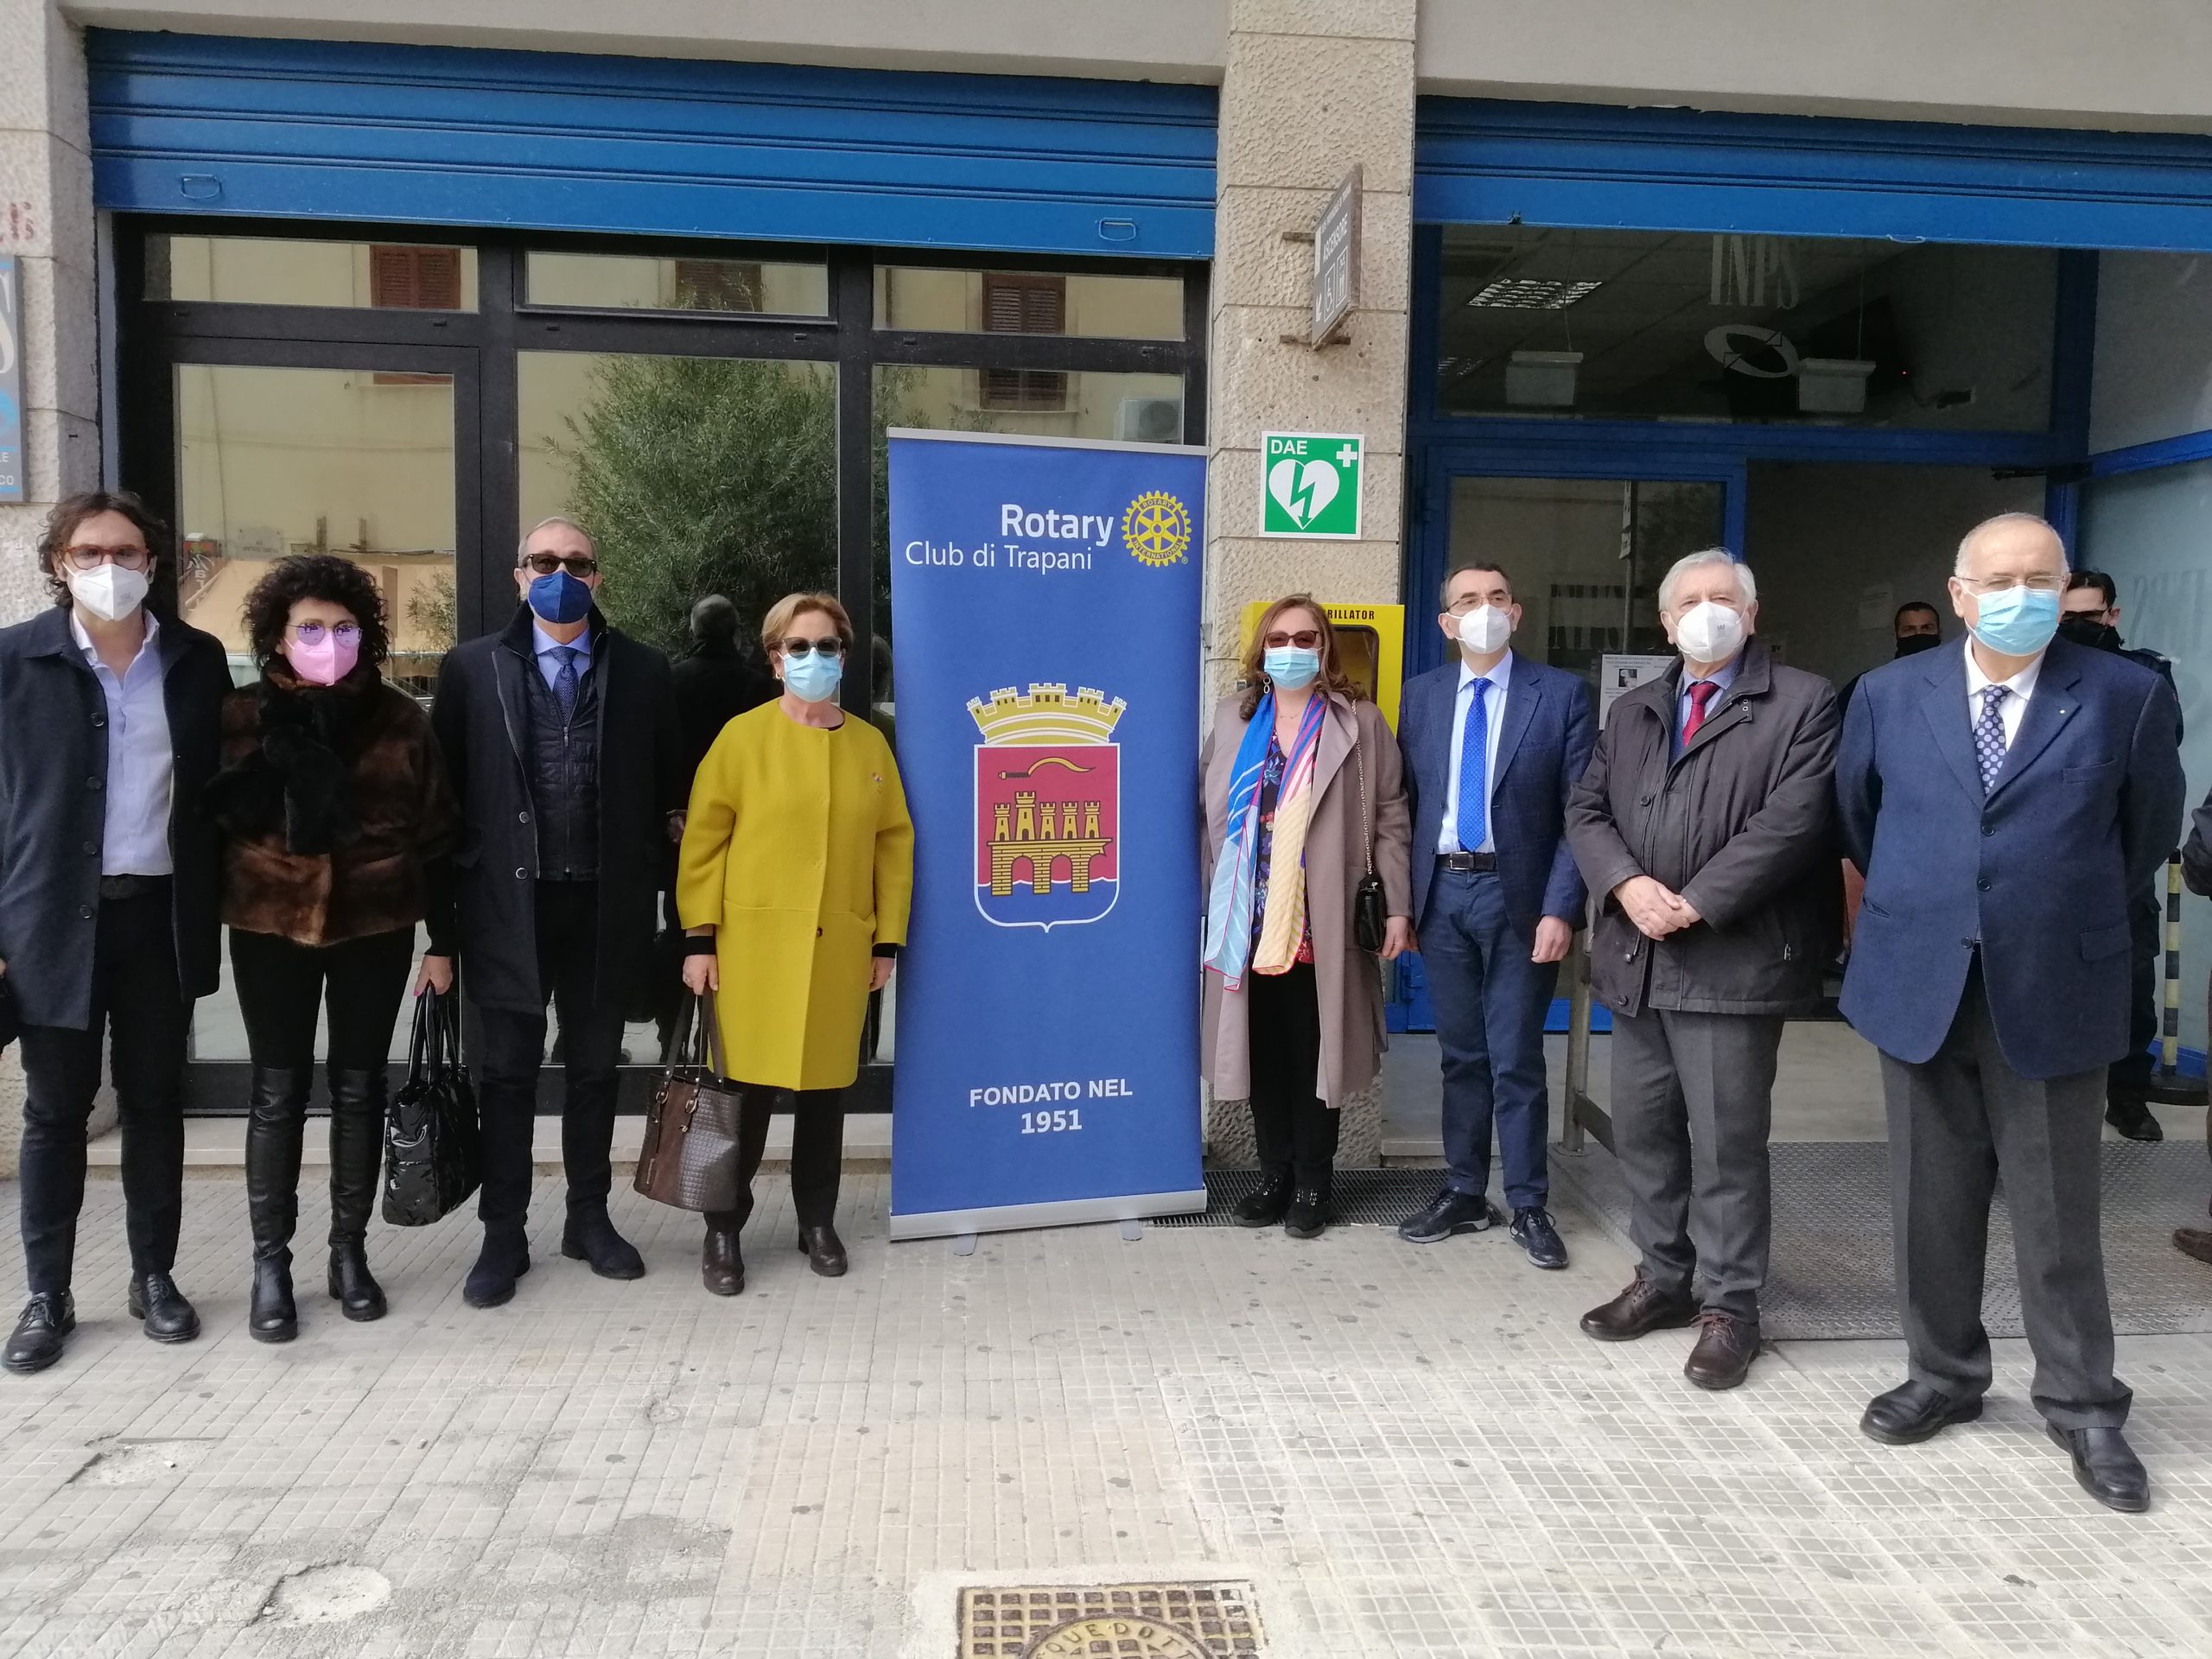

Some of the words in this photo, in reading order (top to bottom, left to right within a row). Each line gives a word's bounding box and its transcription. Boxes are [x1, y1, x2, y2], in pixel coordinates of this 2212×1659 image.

[1270, 439, 1308, 455] DAE
[1142, 499, 1173, 509] ROTARY
[1001, 504, 1114, 547] Rotary
[906, 541, 964, 566] Club
[973, 543, 995, 568] di
[1004, 544, 1092, 575] Trapani
[1133, 539, 1182, 560] INTERNATIONAL
[1327, 609, 1375, 620] RILLATOR
[969, 1081, 1081, 1108] FONDATO
[1089, 1078, 1134, 1098] NEL
[1021, 1109, 1083, 1135] 1951
